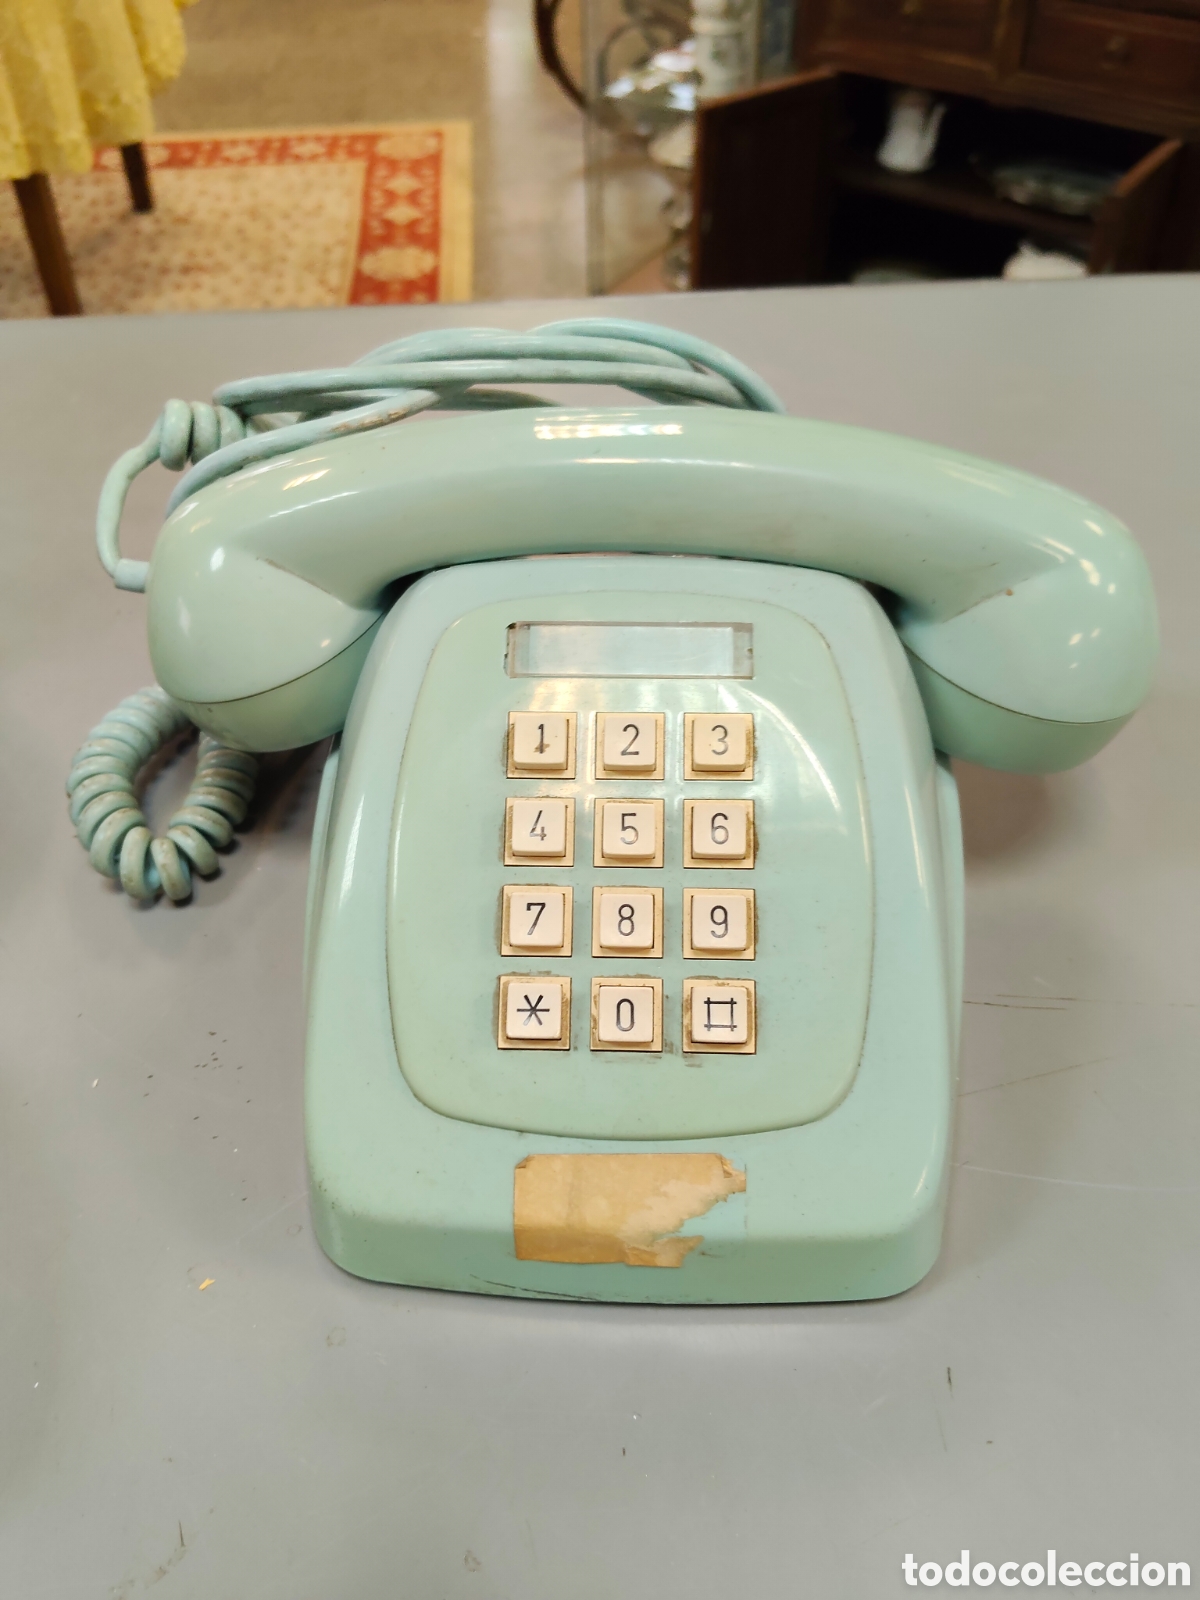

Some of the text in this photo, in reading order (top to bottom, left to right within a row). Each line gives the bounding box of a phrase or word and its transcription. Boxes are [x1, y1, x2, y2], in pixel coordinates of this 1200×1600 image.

[537, 723, 730, 756] 1 2 3
[529, 809, 730, 845] 4 5 6
[525, 902, 729, 939] 7 8 9
[616, 998, 635, 1032] 0
